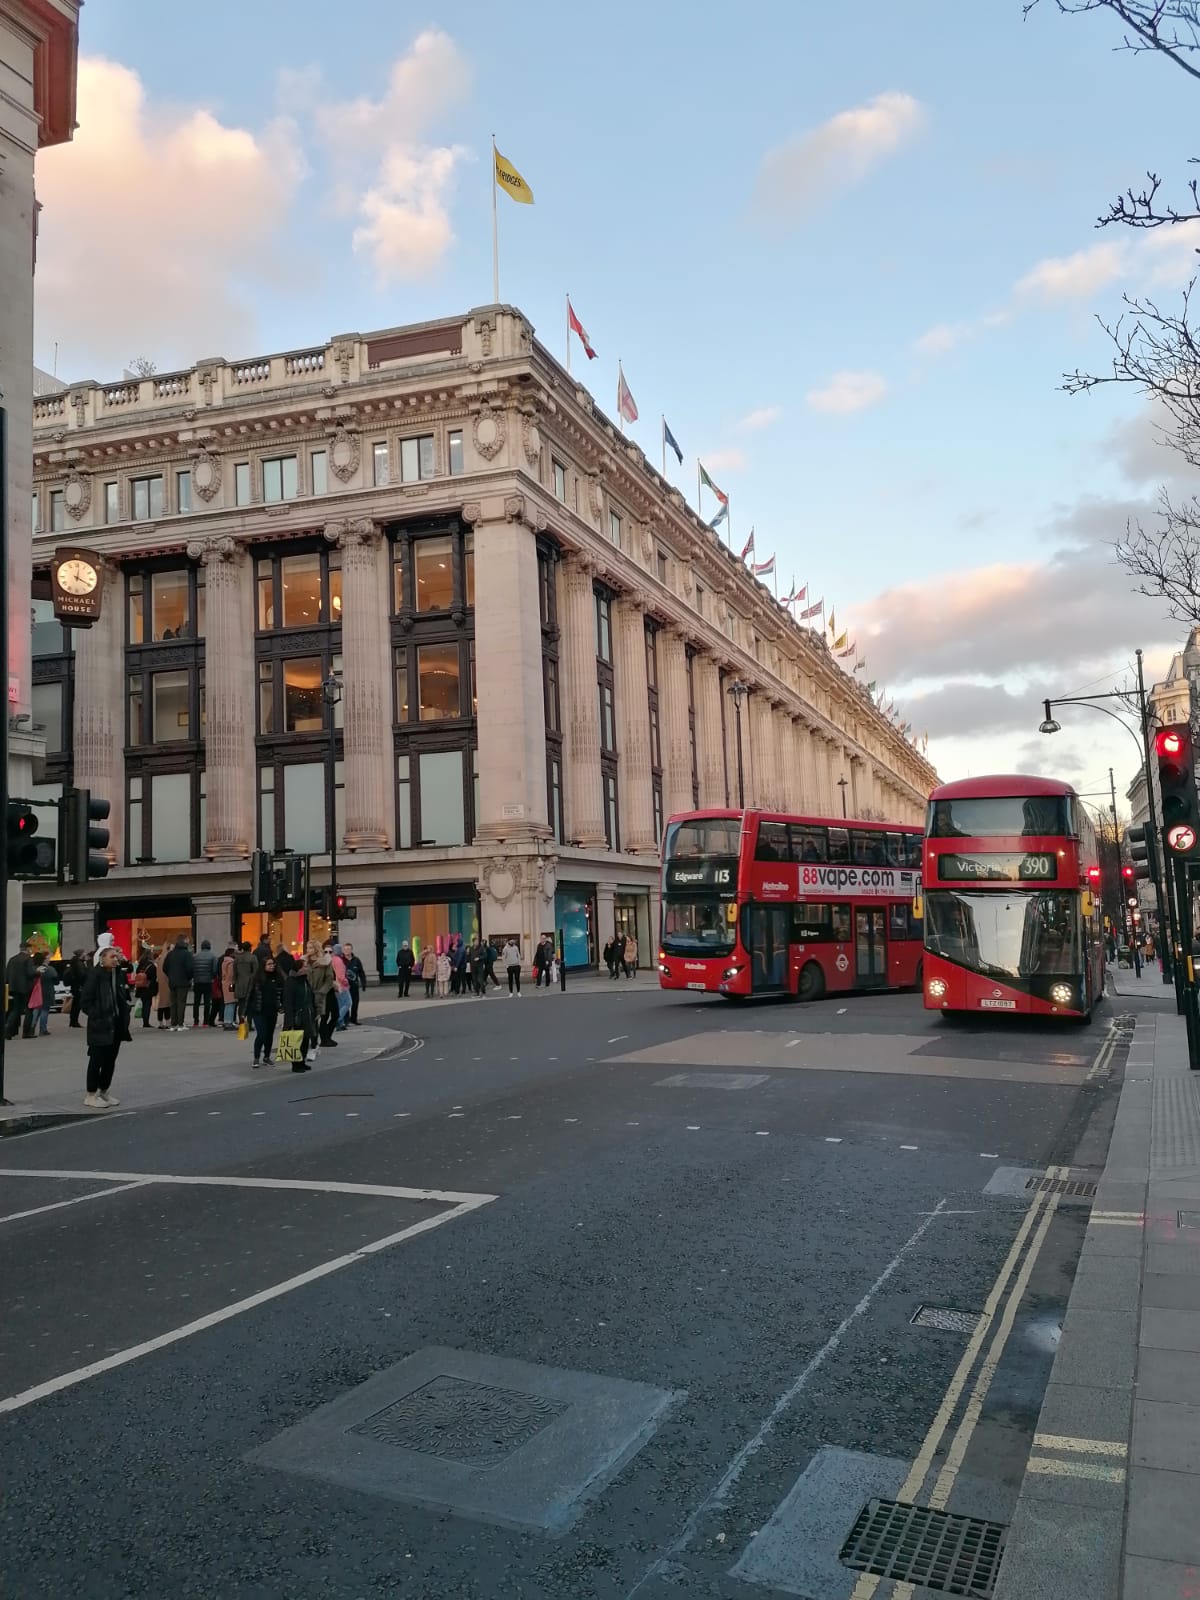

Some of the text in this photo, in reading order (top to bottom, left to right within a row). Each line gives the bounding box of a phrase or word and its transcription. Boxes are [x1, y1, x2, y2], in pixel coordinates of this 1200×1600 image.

[57, 596, 96, 605] MICHAEL
[61, 604, 92, 613] HOUSE
[1024, 856, 1049, 875] 390
[674, 872, 704, 883] Edgware
[714, 869, 730, 883] 113
[803, 867, 895, 890] 88vape.com
